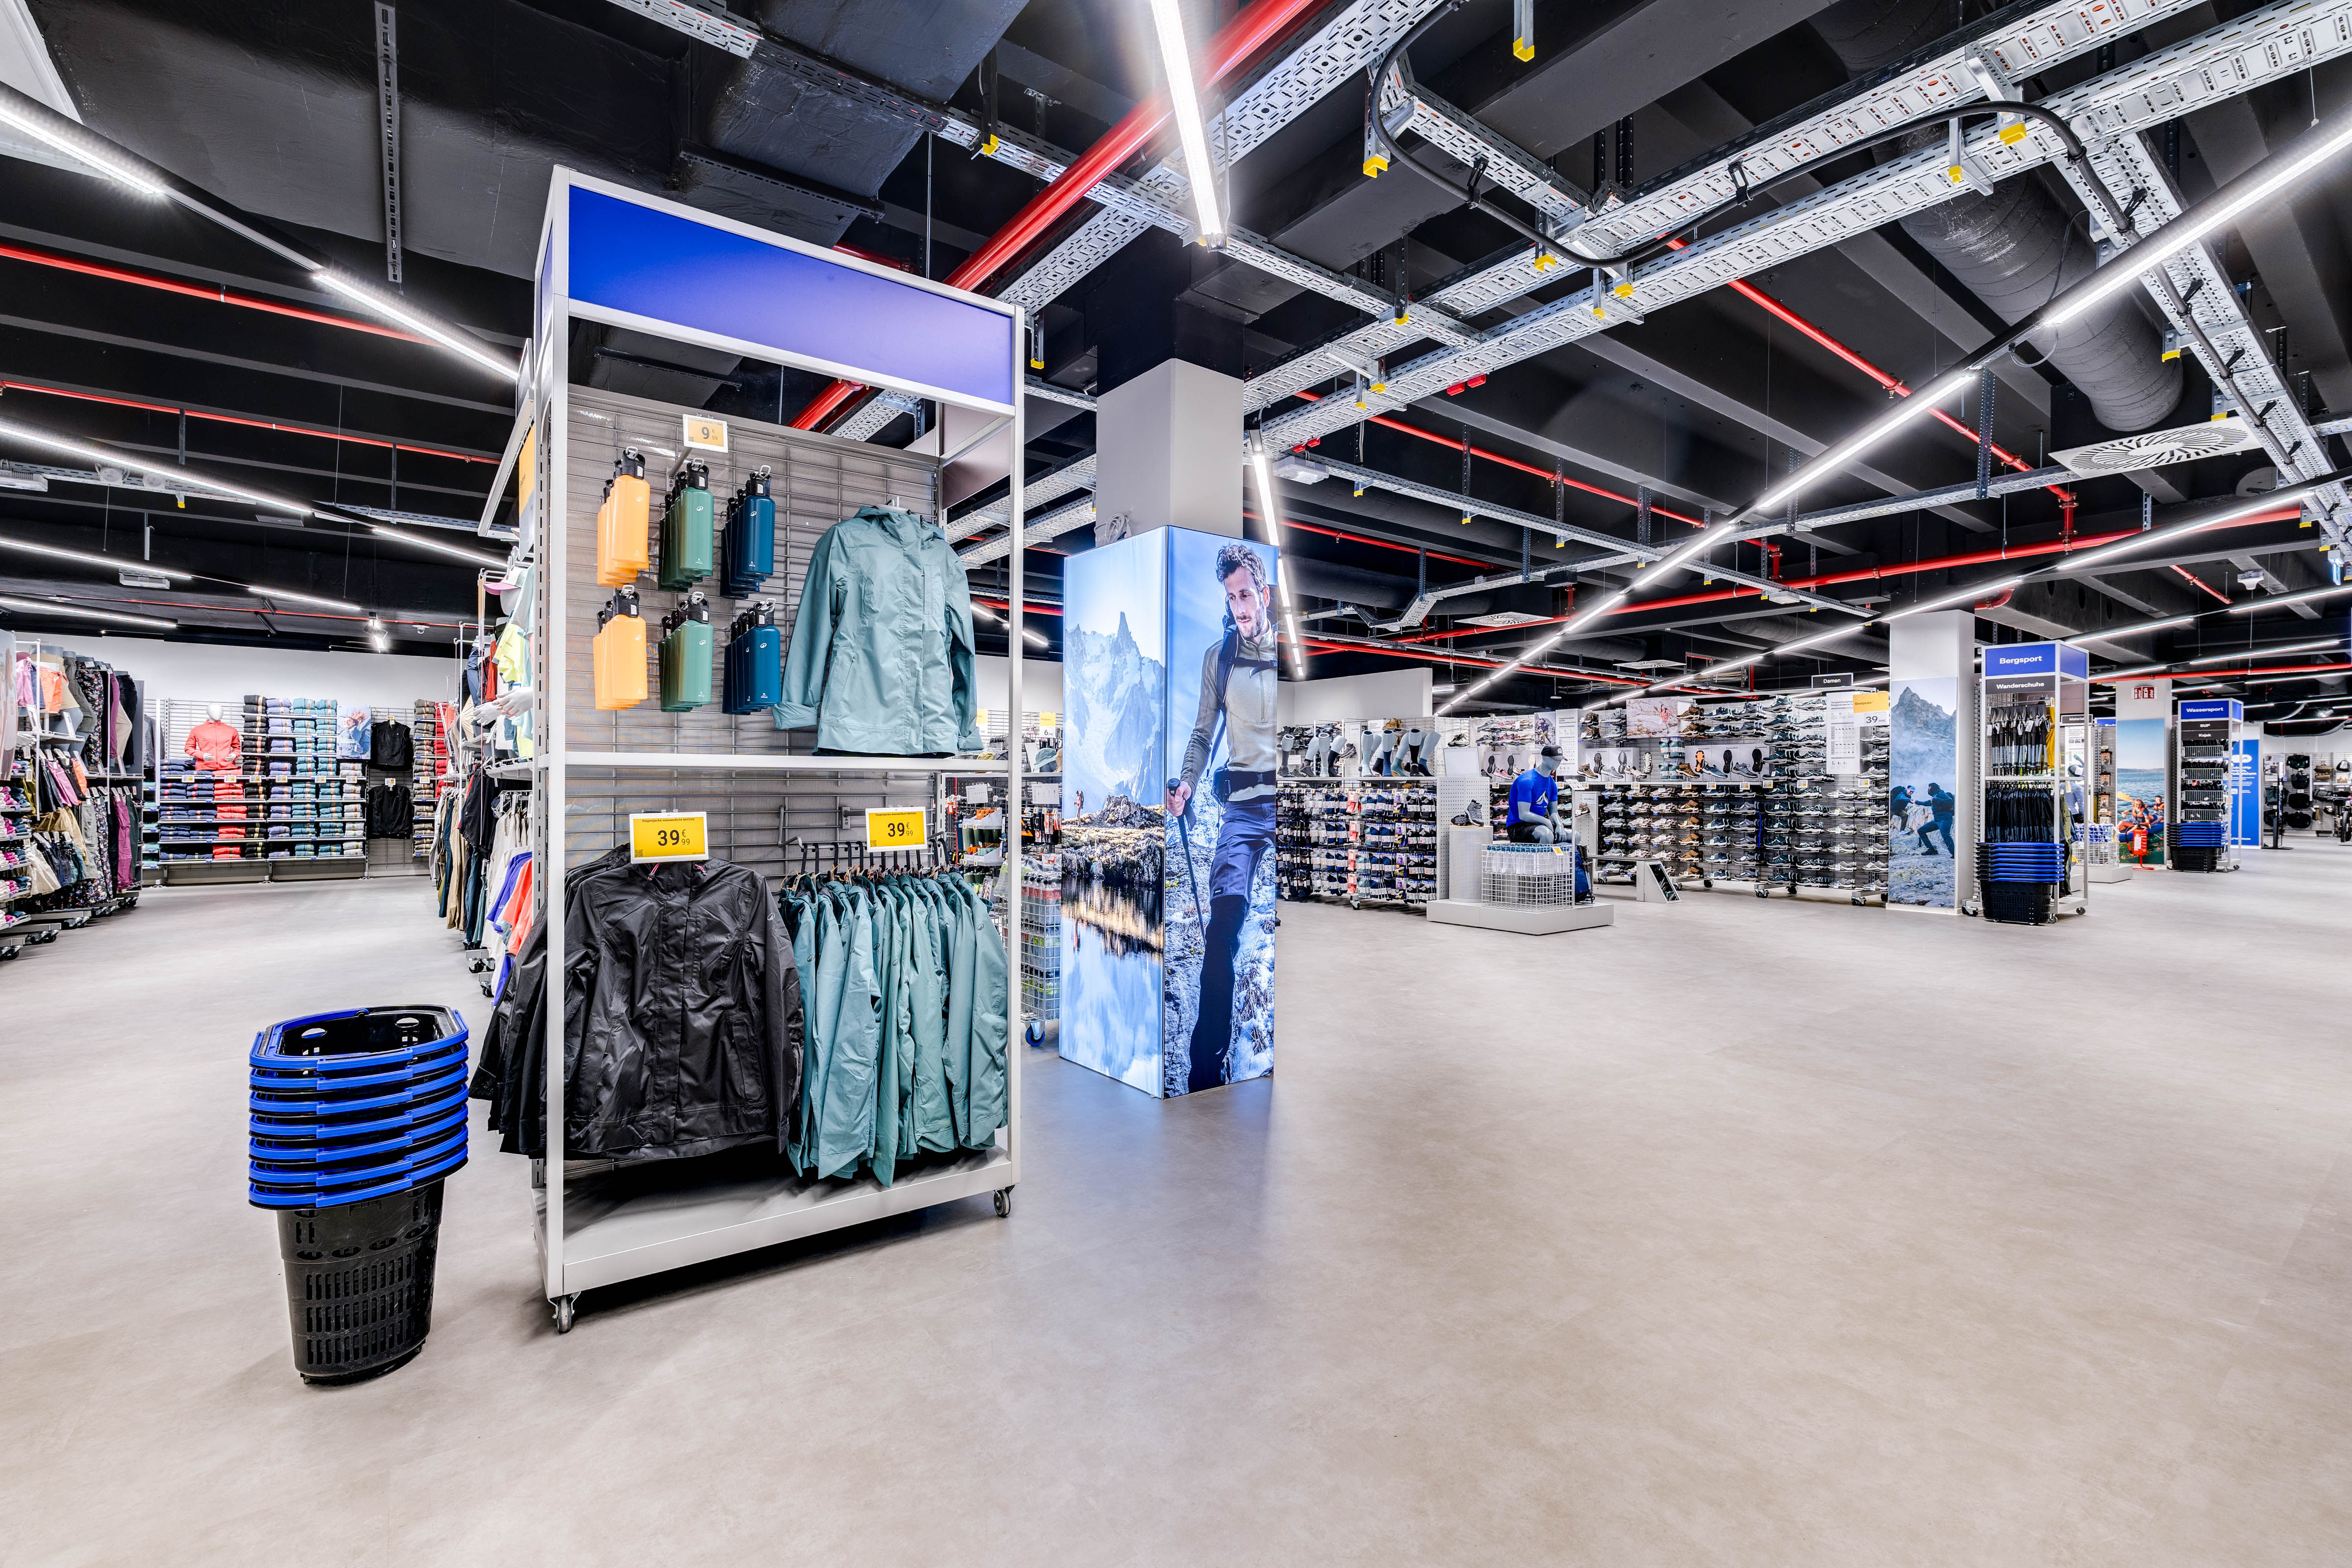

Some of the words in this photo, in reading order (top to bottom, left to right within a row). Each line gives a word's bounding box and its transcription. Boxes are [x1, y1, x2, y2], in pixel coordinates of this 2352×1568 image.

[701, 427, 710, 439] 9
[1999, 655, 2042, 664] Bergsport
[887, 823, 905, 837] 39
[658, 830, 680, 846] 39
